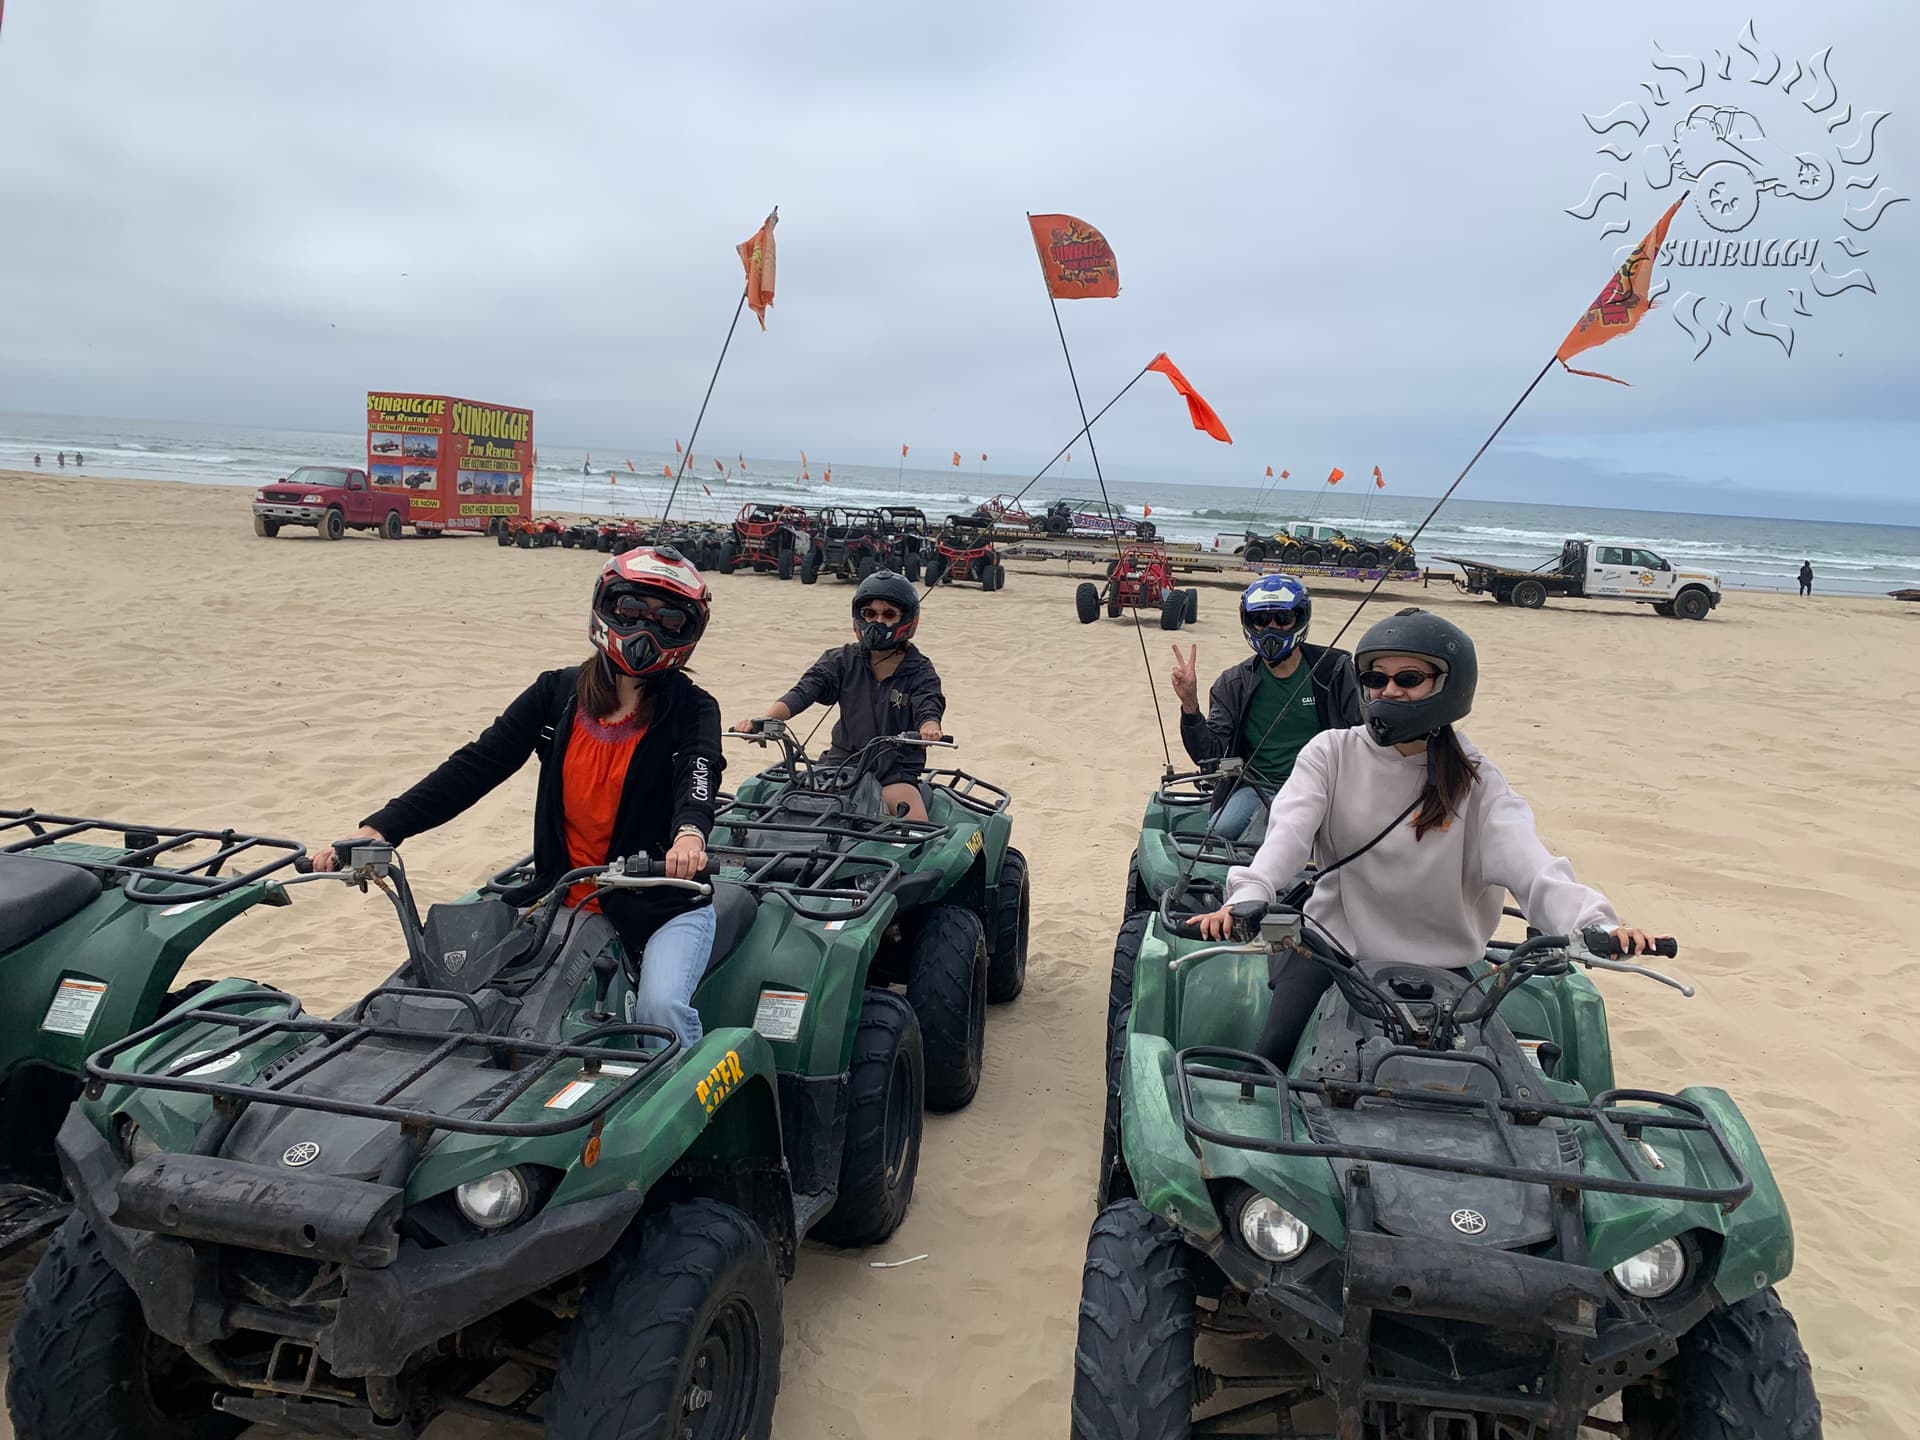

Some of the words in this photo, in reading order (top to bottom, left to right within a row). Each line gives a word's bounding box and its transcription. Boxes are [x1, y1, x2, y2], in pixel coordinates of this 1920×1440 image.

[368, 395, 446, 415] SUNBUGGIE
[452, 401, 529, 441] SUNBUGGIE
[461, 504, 475, 514] RENT
[475, 504, 488, 514] HERE
[494, 504, 504, 514] RIDE
